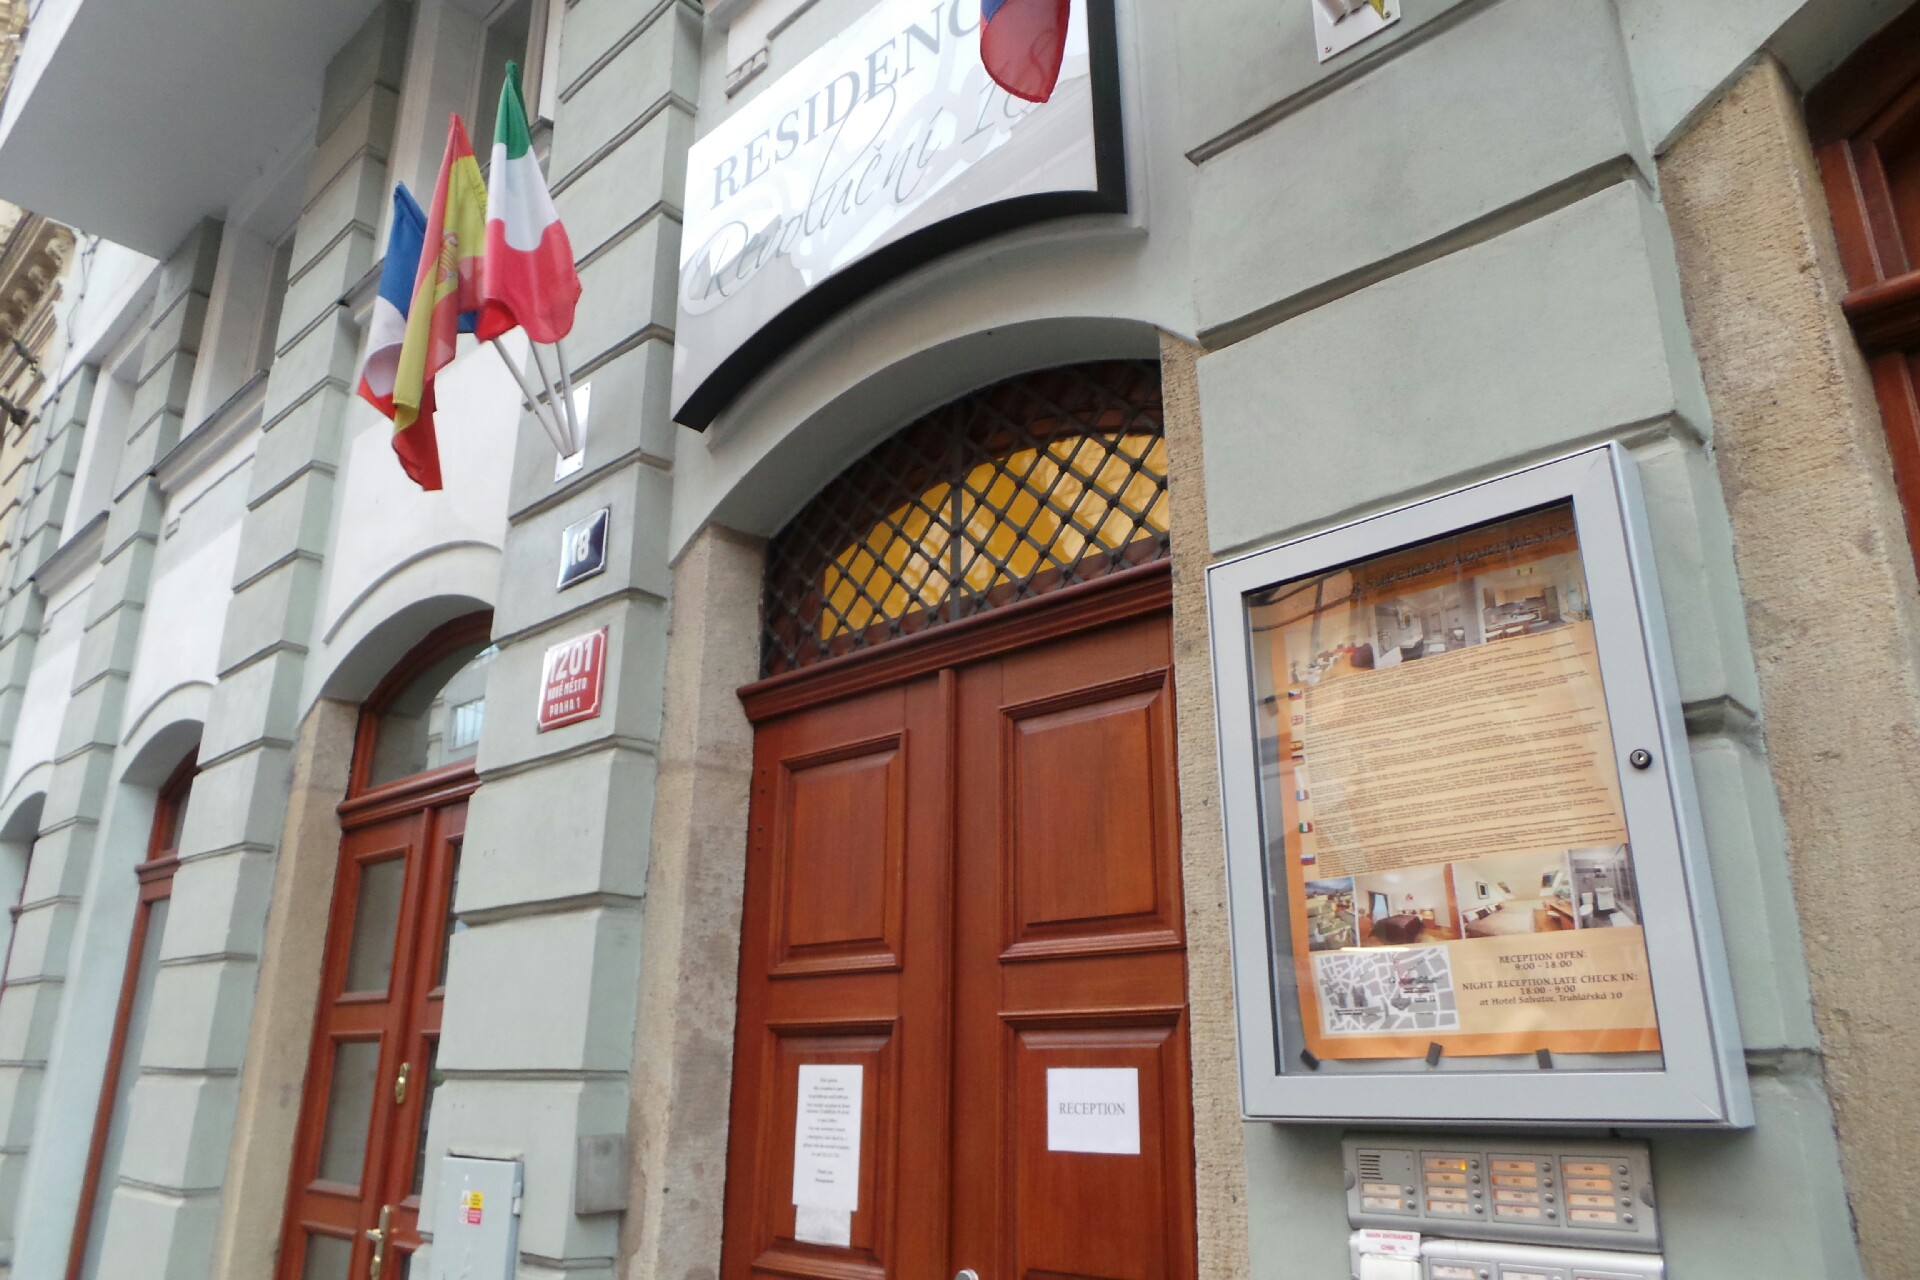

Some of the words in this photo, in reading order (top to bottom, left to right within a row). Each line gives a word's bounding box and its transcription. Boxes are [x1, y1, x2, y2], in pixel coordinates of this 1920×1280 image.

[710, 0, 981, 210] RESIDENC
[571, 527, 591, 566] 18
[548, 635, 594, 684] 1201
[547, 680, 564, 701] NOVÉ
[549, 699, 575, 717] PRAHA
[576, 697, 581, 709] 1
[1499, 952, 1553, 964] RECEPTION
[1556, 950, 1588, 960] OPEN:
[1514, 962, 1535, 971] 9:00
[1545, 960, 1572, 969] 18:00
[1462, 981, 1493, 991] NIGHT
[1581, 974, 1618, 984] CHECK
[1621, 973, 1639, 982] IN:
[1520, 986, 1546, 995] 18:00
[1554, 985, 1576, 994] 9:00
[1492, 996, 1516, 1006] Hotel
[1610, 992, 1623, 1000] 10
[1059, 1102, 1126, 1116] RECEPTION
